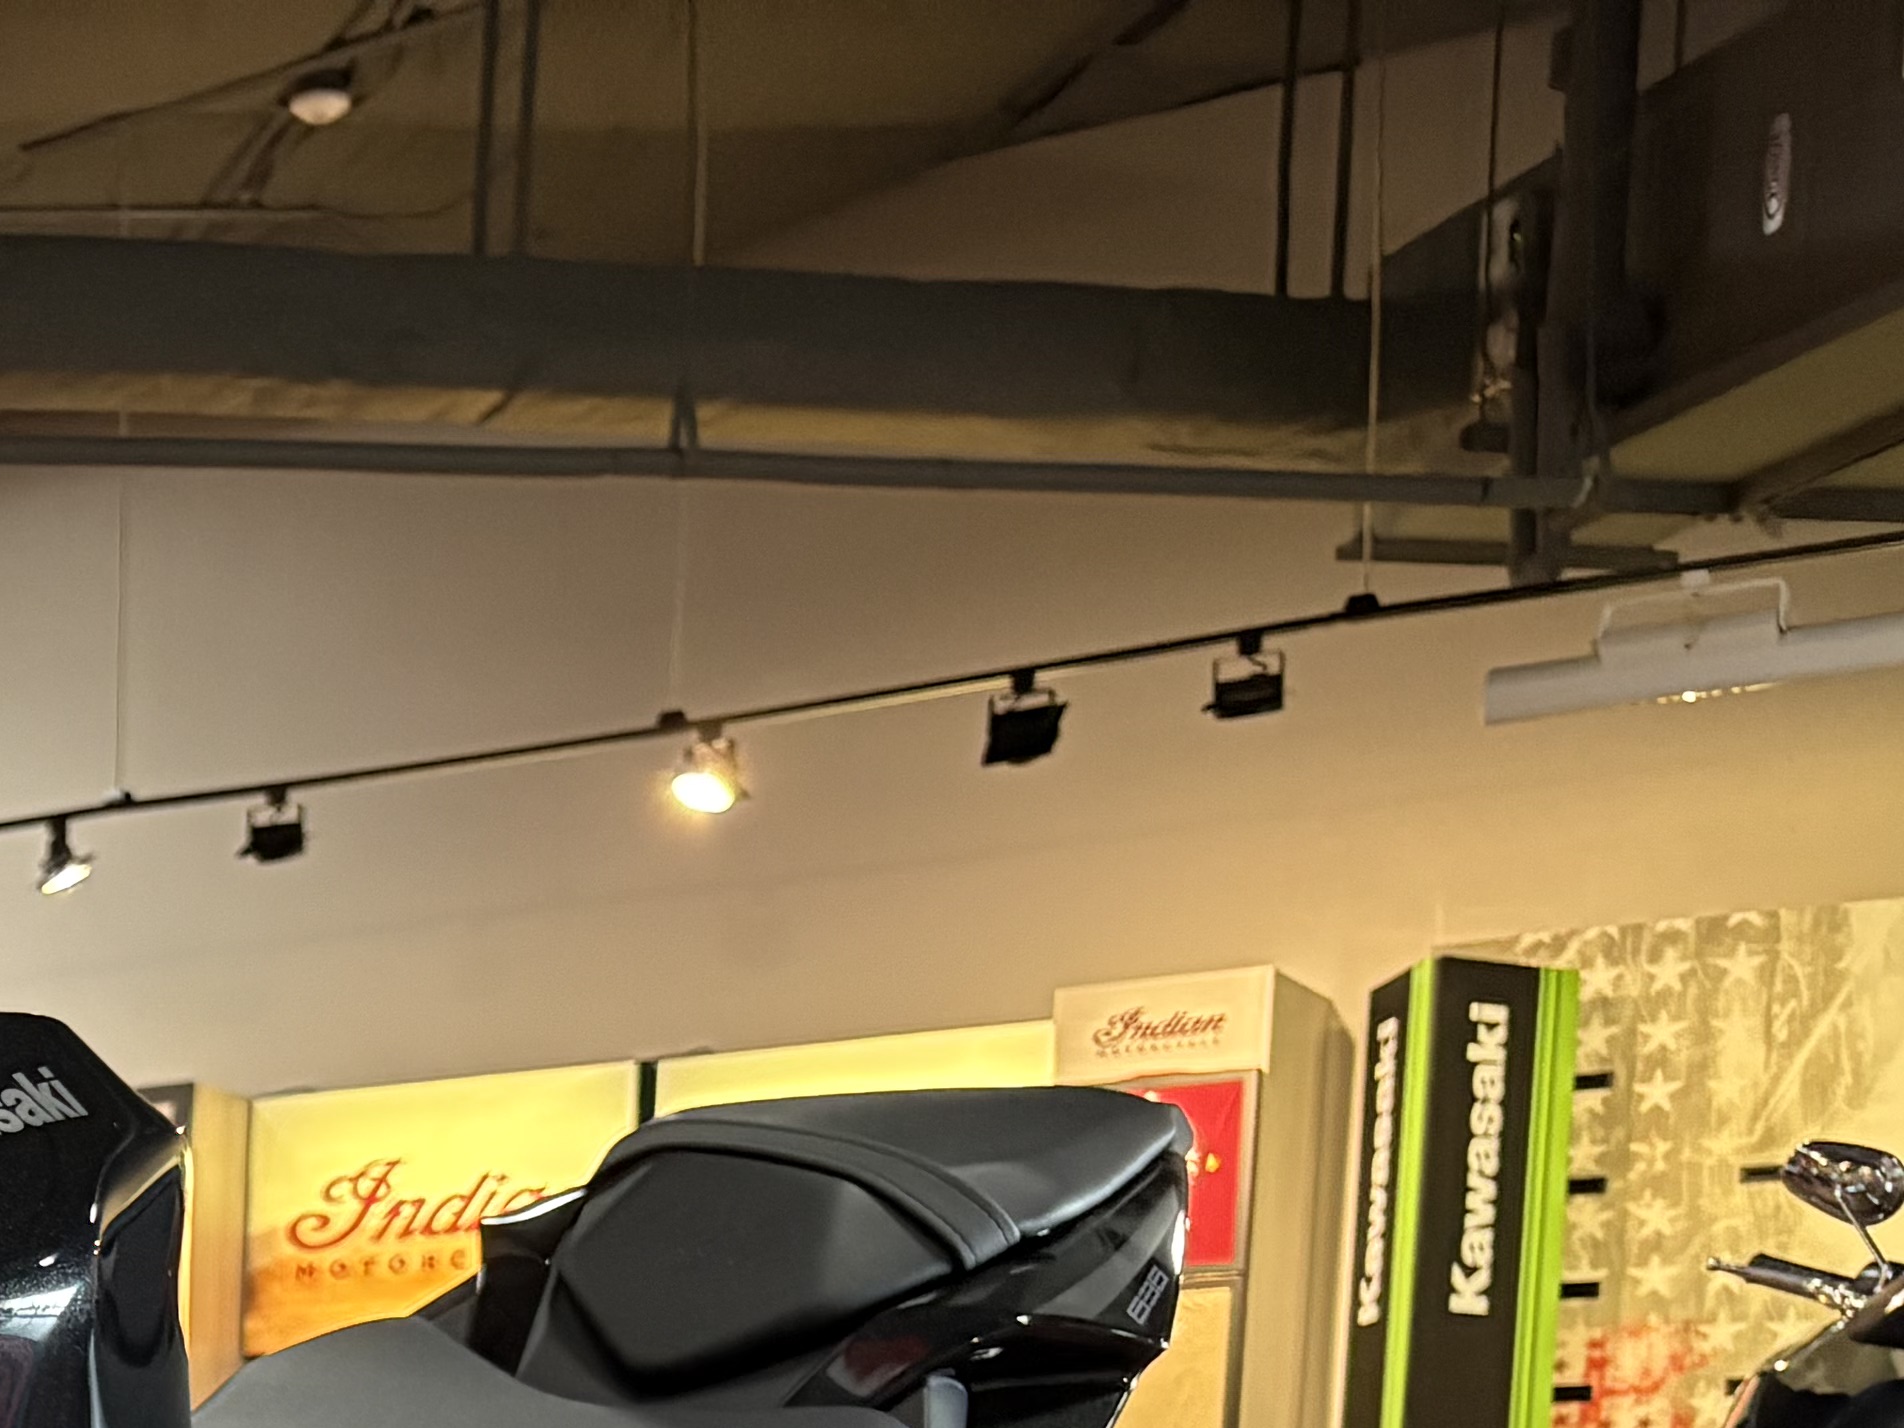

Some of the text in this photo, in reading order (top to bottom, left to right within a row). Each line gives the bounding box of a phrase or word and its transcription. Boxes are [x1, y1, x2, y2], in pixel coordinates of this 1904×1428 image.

[1093, 1006, 1227, 1048] Indian
[287, 1156, 548, 1251] Indi
[1357, 1016, 1399, 1326] Kawasaki
[1448, 1001, 1510, 1316] Kawasaki
[295, 1250, 469, 1281] MOTORC
